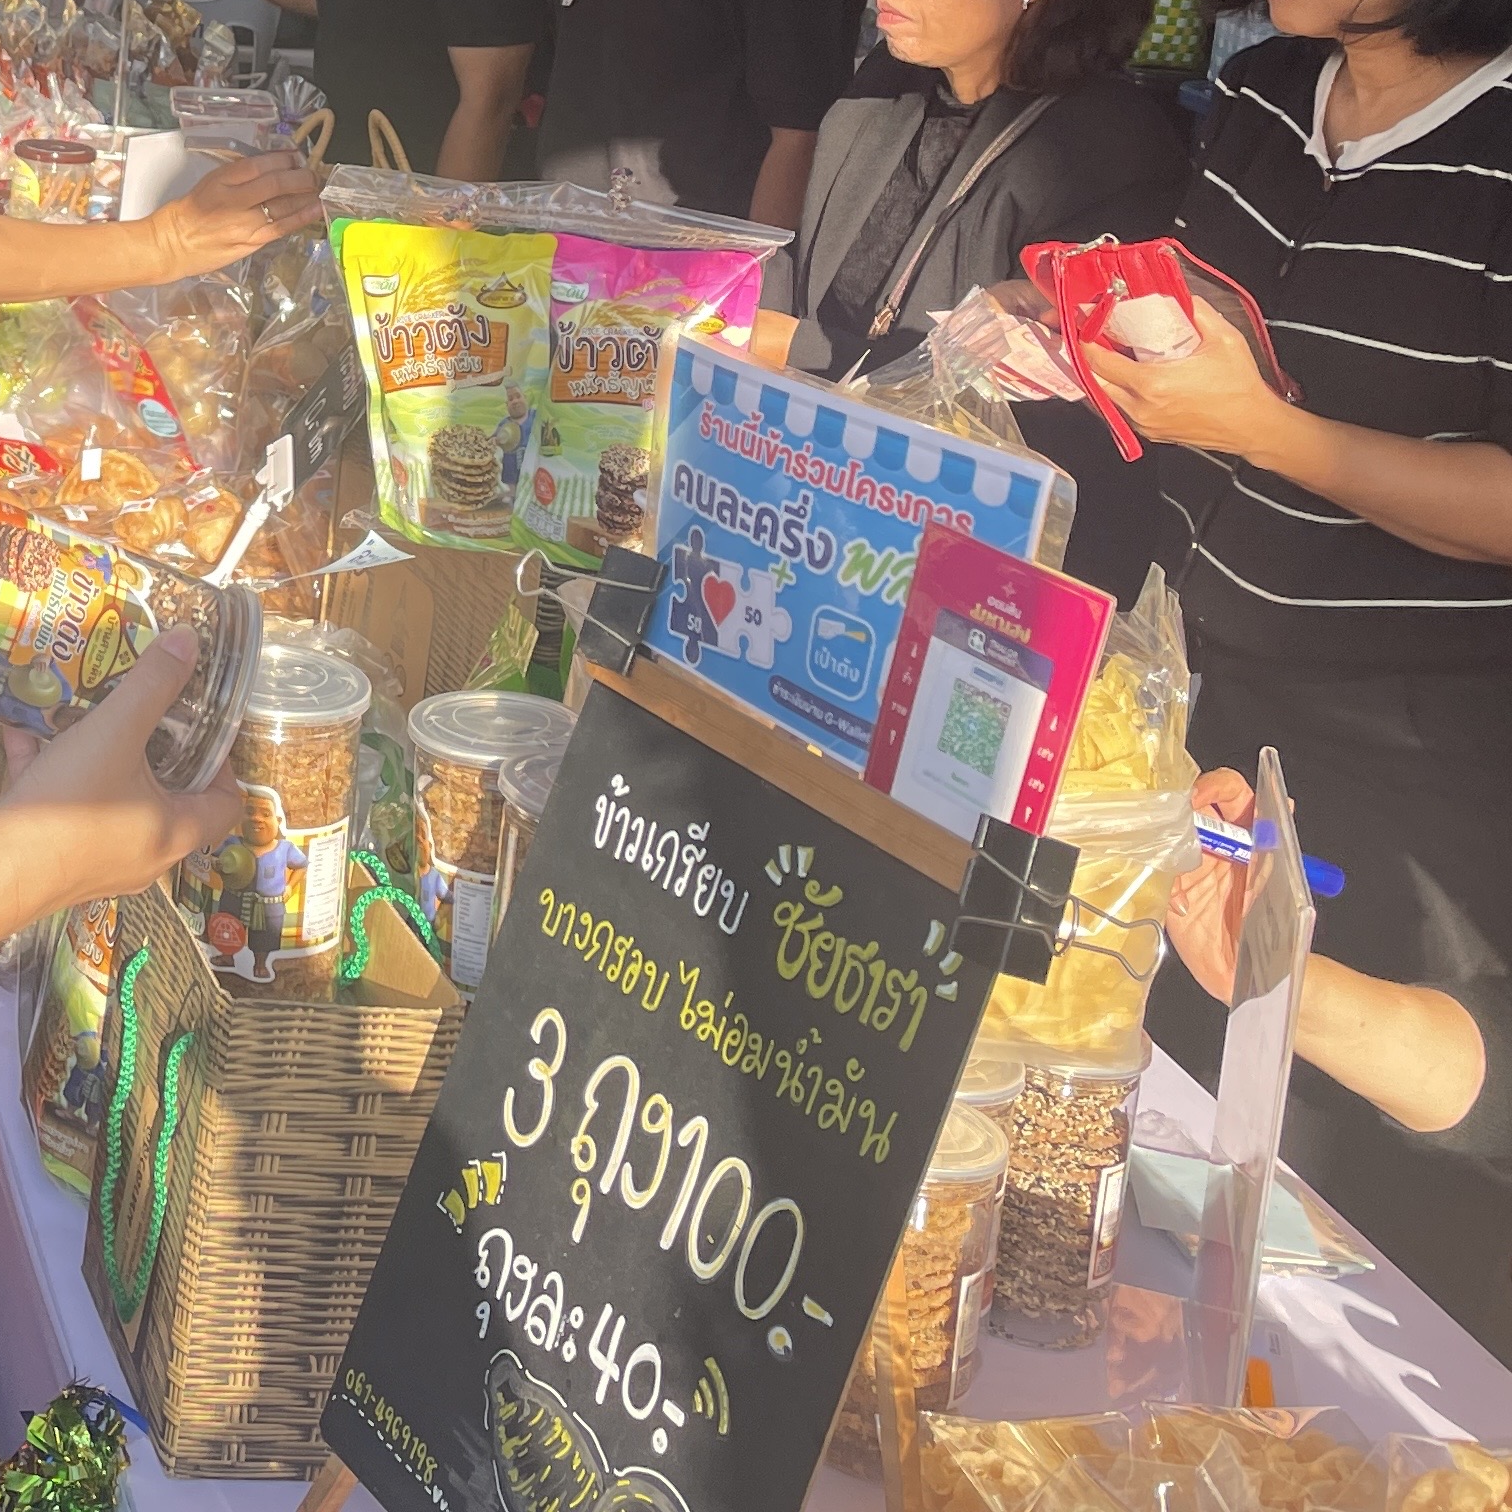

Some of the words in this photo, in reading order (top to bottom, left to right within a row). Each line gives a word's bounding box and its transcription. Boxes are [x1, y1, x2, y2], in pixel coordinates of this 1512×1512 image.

[374, 302, 489, 362] ข้าวตัง
[391, 351, 483, 385] หน้าธัญพืช
[557, 320, 662, 372] ข้าวตั
[699, 402, 974, 536] ร้านนี้เข้าร่วมโครงการ
[675, 464, 833, 569] คนละครึ่ง
[51, 571, 99, 662] ข้าวตัง
[688, 614, 702, 633] 50
[744, 605, 762, 627] 50
[594, 773, 751, 935] ข้าวเกรียบ
[538, 888, 670, 1012] บางกรอบ
[678, 959, 895, 1163] ไม่อมน้ำมัน
[502, 1007, 569, 1149] 3
